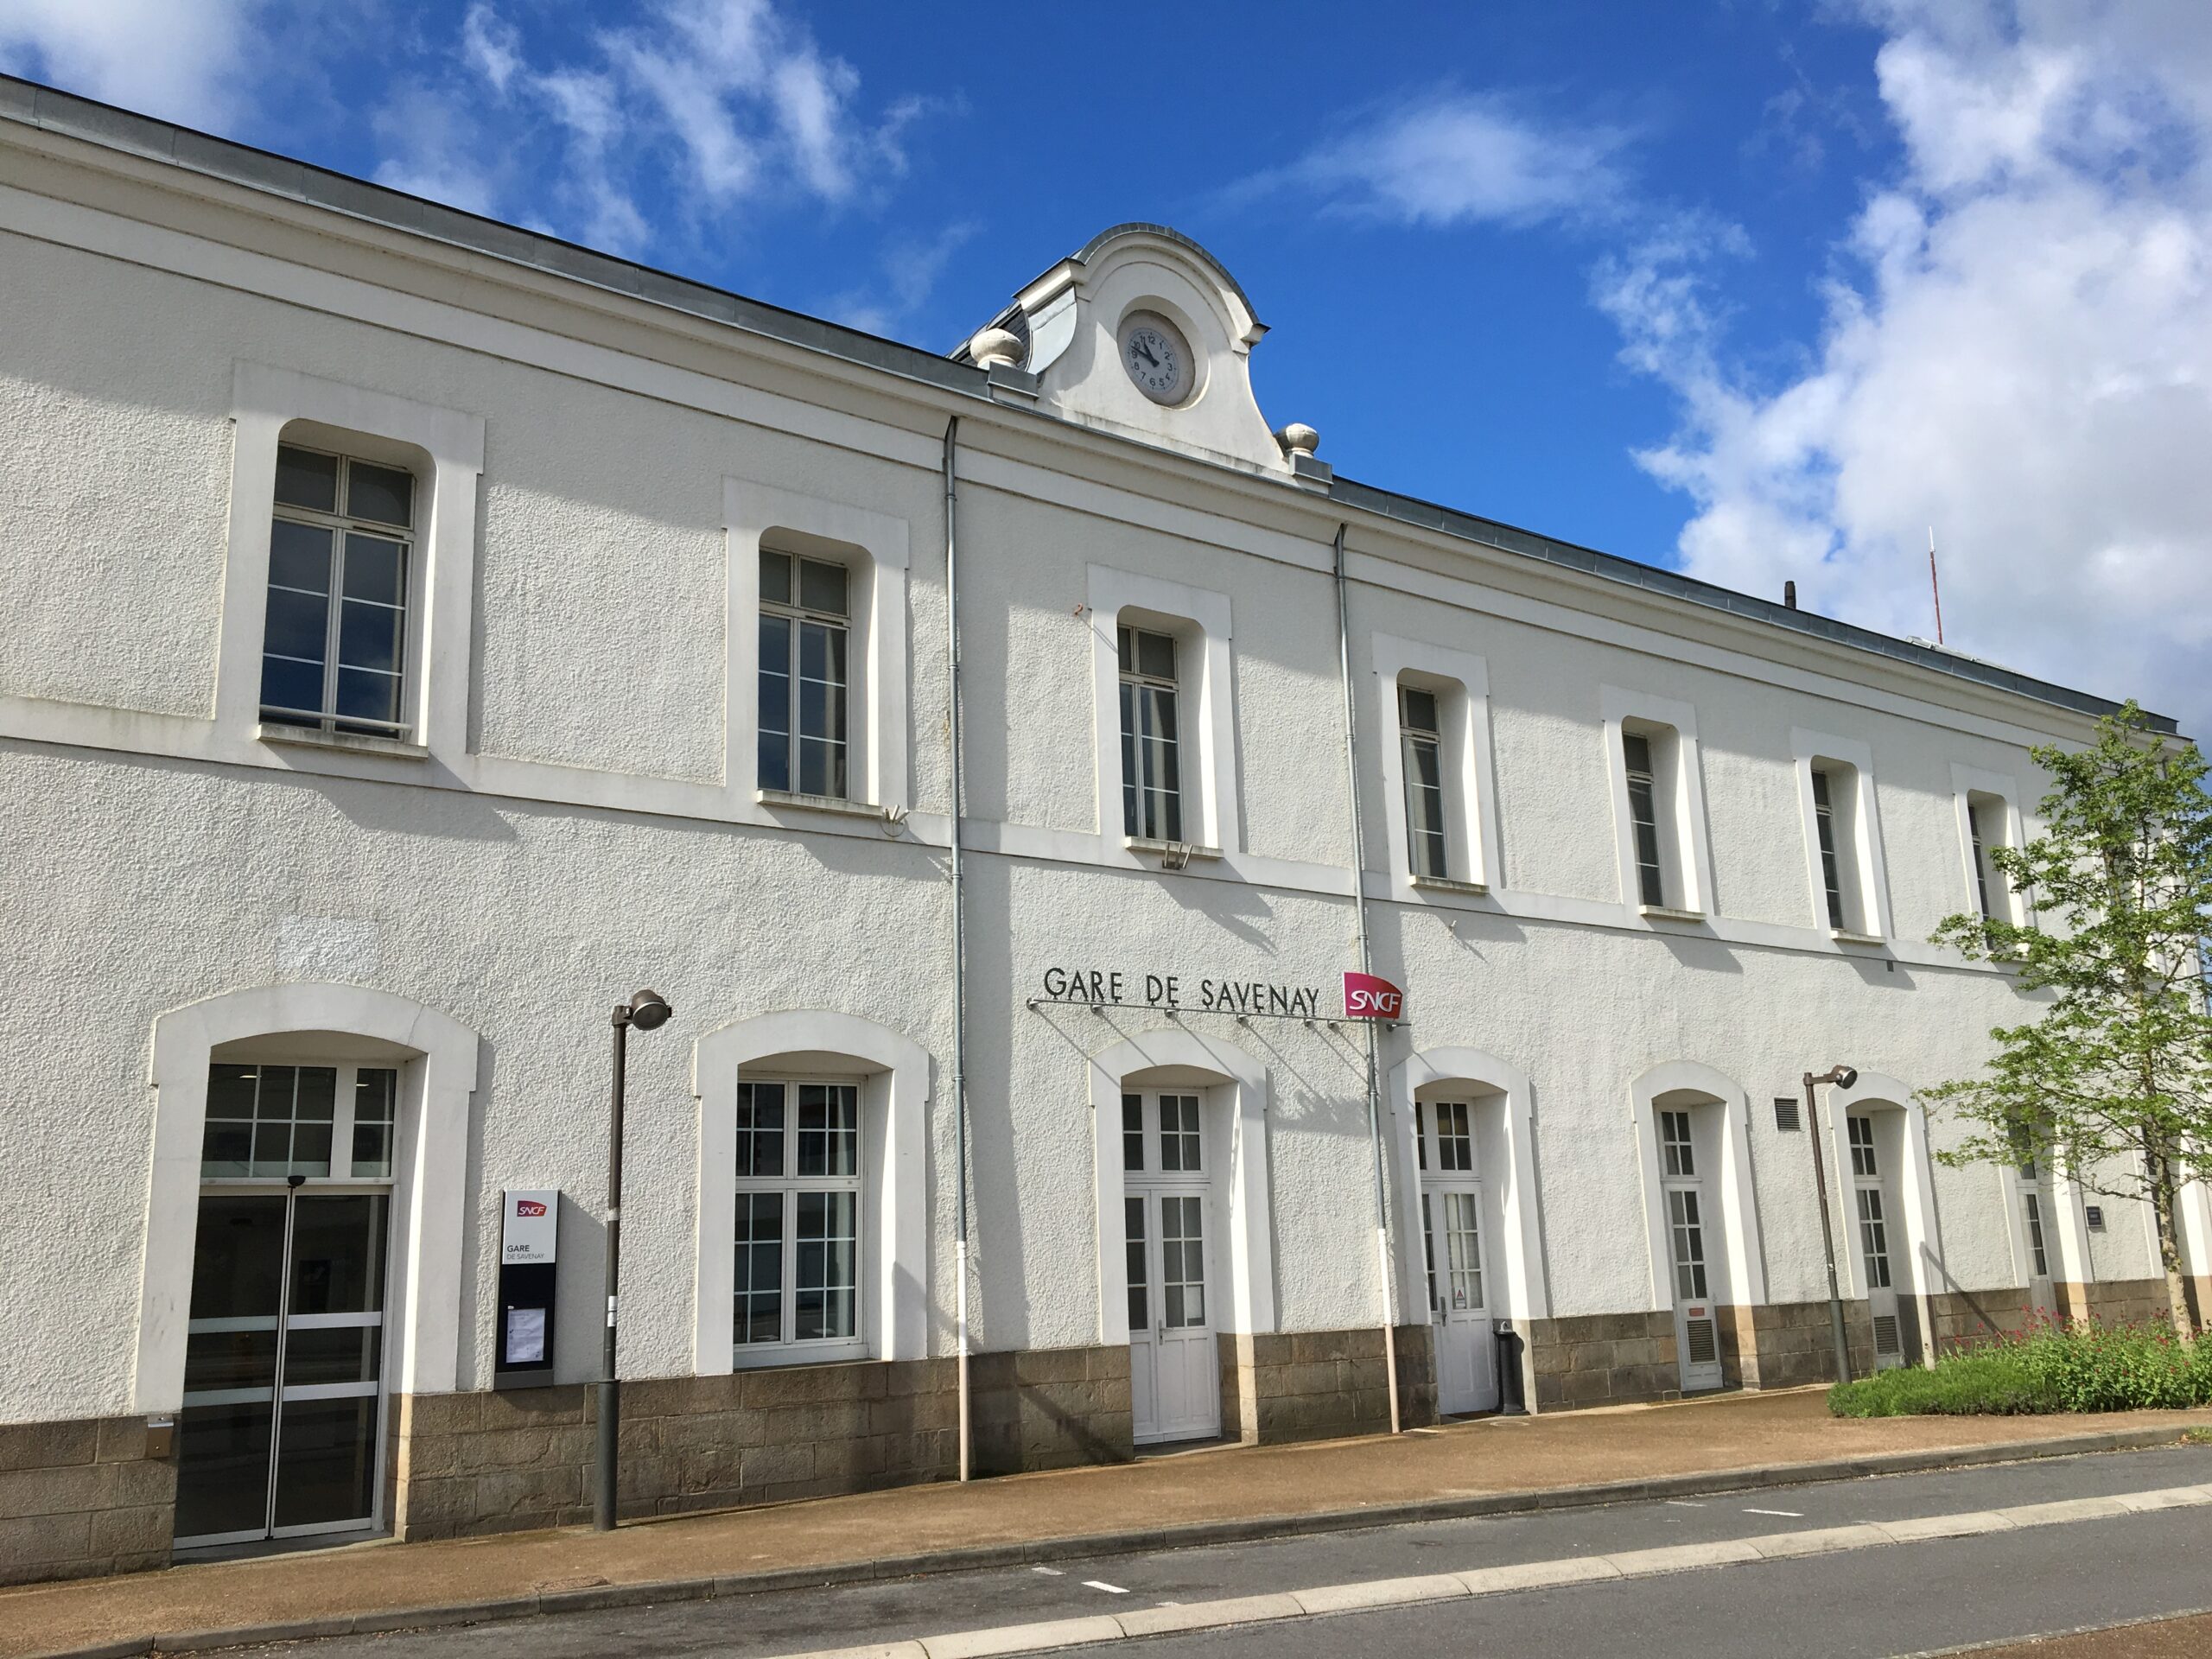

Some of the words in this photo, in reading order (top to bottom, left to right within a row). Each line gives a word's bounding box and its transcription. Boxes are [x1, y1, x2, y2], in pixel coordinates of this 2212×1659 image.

[1147, 335, 1155, 345] 12
[1134, 341, 1140, 350] 10
[1131, 350, 1138, 359] 9
[1164, 352, 1170, 360] 2
[1134, 362, 1139, 370] 8
[1167, 363, 1173, 371] 3
[1150, 378, 1156, 386] 6
[1159, 378, 1164, 386] 5
[1044, 967, 1123, 1001] GARE
[1146, 975, 1179, 1003] DE
[1201, 979, 1319, 1014] SAVENAY
[1349, 989, 1401, 1012] SNCF
[518, 1206, 545, 1215] SNCF
